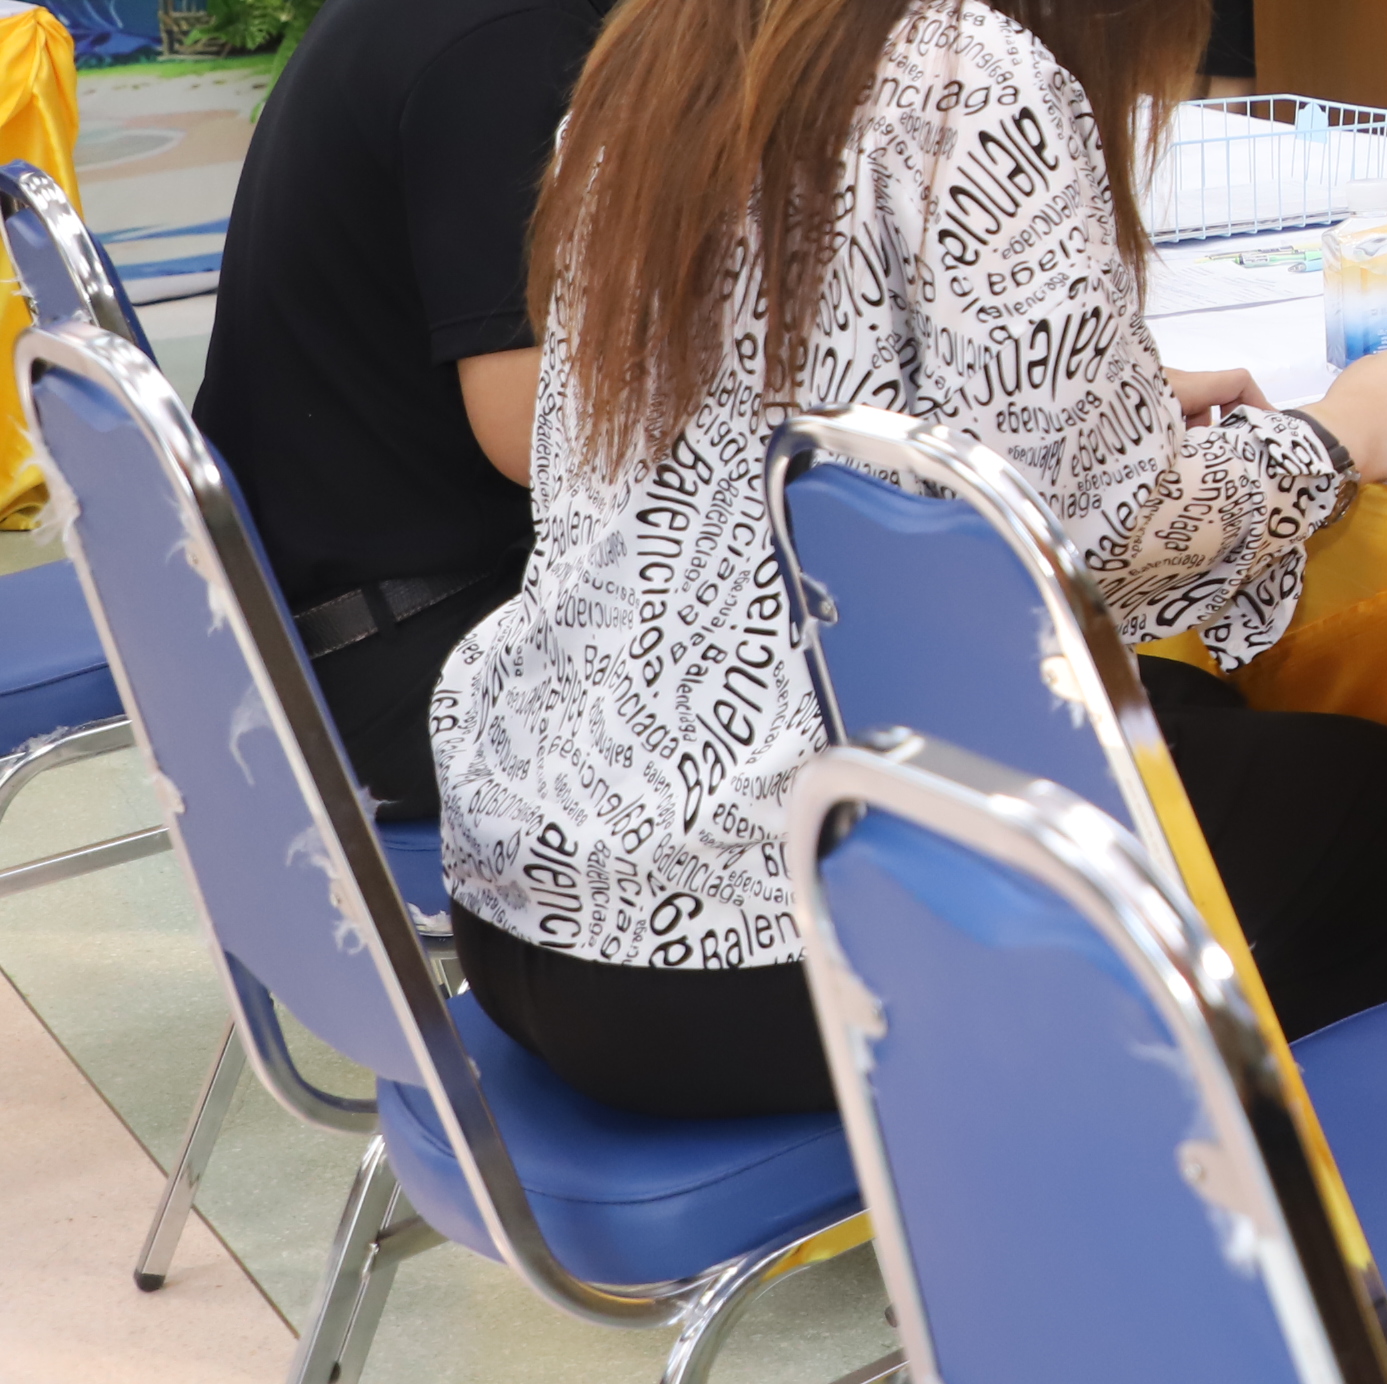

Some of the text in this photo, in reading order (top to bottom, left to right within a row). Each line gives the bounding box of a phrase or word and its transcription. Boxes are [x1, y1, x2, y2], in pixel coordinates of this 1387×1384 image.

[874, 78, 1020, 116] nciaga
[937, 105, 1060, 267] alencia
[677, 552, 784, 837] Balencia
[523, 821, 583, 949] alenci
[700, 908, 801, 968] Balen
